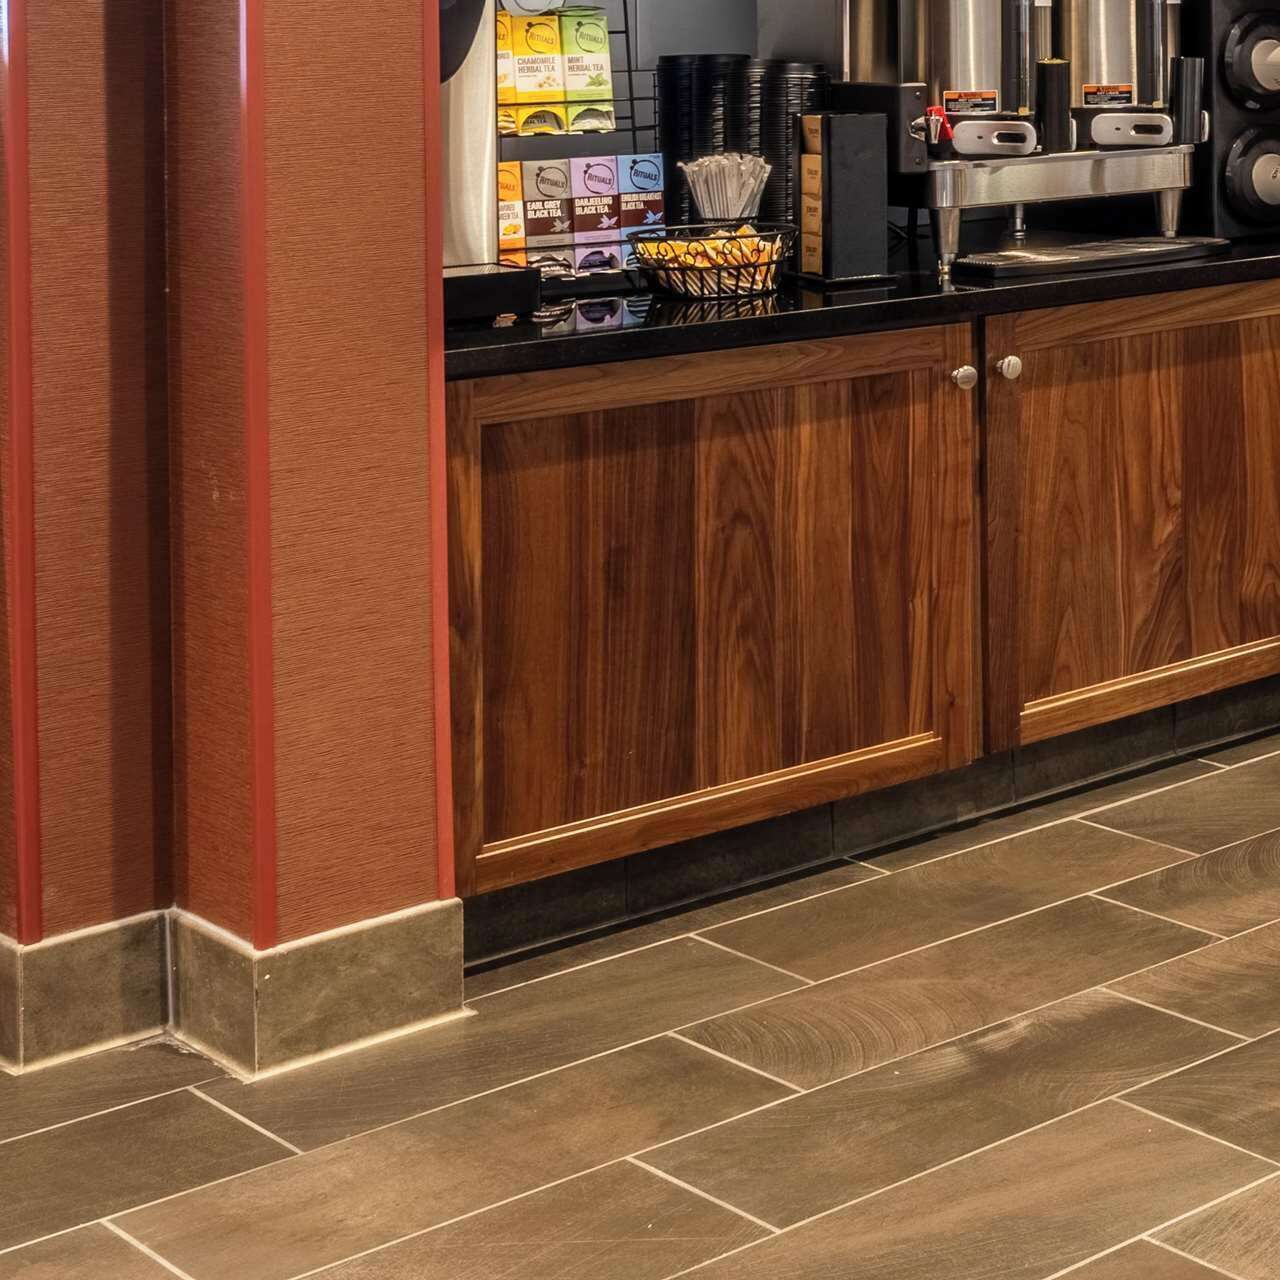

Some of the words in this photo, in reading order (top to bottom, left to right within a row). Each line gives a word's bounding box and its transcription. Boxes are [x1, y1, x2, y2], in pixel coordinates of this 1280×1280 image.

[517, 56, 555, 66] CHAMOMILE
[567, 56, 584, 64] MINT
[518, 65, 543, 74] HERBAL
[543, 64, 556, 73] TEA
[567, 64, 592, 72] HERBAL
[592, 63, 604, 72] TEA
[633, 169, 658, 182] RITUALS
[527, 201, 543, 211] EARL
[543, 200, 561, 210] GREY
[575, 196, 613, 207] DARJEELING
[527, 209, 549, 220] BLACK
[548, 208, 562, 218] TEA
[575, 205, 597, 216] BLACK
[597, 204, 609, 214] TEA
